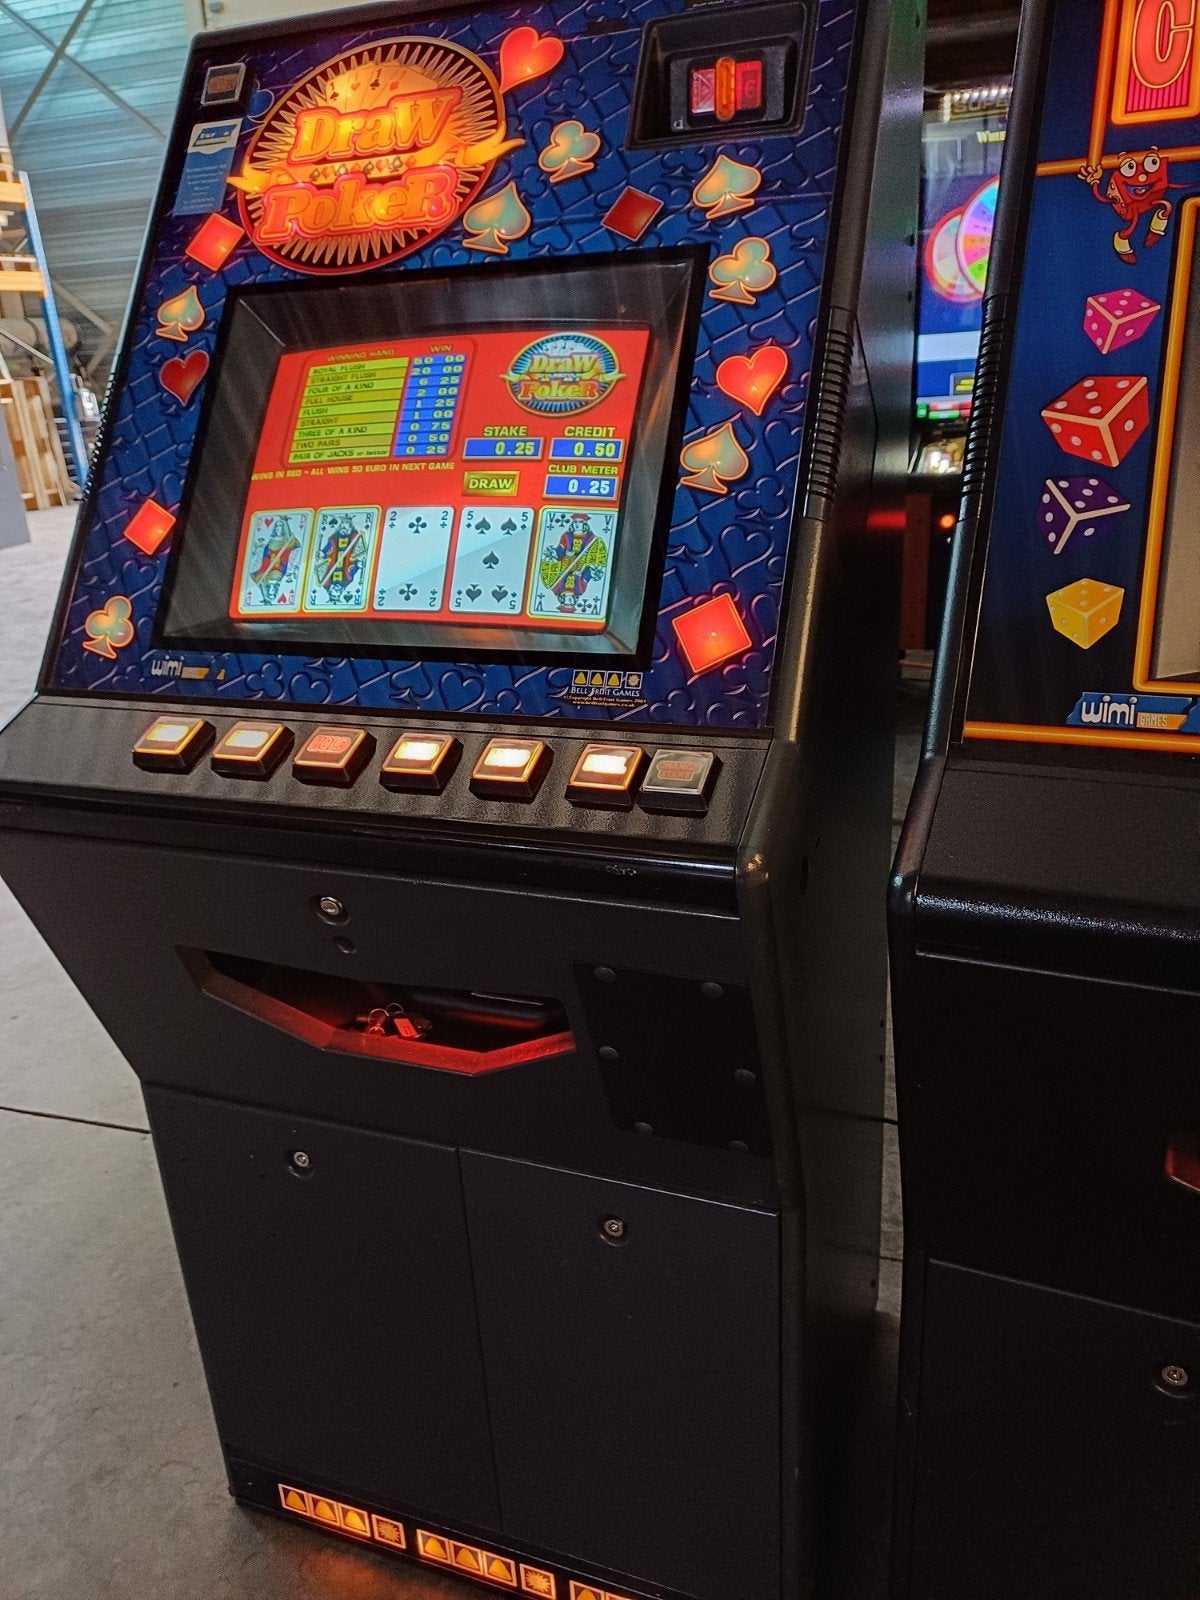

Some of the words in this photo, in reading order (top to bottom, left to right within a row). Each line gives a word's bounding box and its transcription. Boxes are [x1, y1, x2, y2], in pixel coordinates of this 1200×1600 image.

[430, 345, 453, 353] WIN
[328, 352, 366, 362] WINNING
[369, 349, 395, 358] HAND
[313, 367, 336, 375] ROYAL
[340, 363, 366, 372] FLUSH
[310, 373, 347, 384] STRAIGHT
[350, 371, 377, 380] FLUSH
[307, 386, 329, 395] FOUR
[354, 381, 375, 390] KIND
[305, 396, 323, 405] FULL
[326, 394, 353, 403] HOUSE
[302, 407, 329, 416] FLUSH
[300, 417, 339, 428] STRAIGHT
[298, 429, 321, 438] THREE
[347, 425, 368, 434] KIND
[484, 426, 528, 437] STAKE
[564, 426, 616, 438] CREDIT
[295, 441, 315, 449] TWO
[316, 439, 341, 447] PAIRS
[494, 441, 536, 456] 0.25
[573, 441, 617, 456] 0.50
[293, 451, 311, 460] PAIR
[313, 450, 325, 459] OF
[327, 449, 355, 458] JACKS
[274, 471, 285, 479] IN
[286, 470, 302, 478] RED
[310, 468, 325, 476] ALL
[327, 466, 350, 475] WINS
[351, 465, 364, 473] 50
[365, 464, 386, 473] EURO
[389, 463, 400, 472] IN
[402, 462, 427, 471] NEXT
[428, 461, 456, 471] GAME
[548, 463, 577, 474] CLUB
[581, 465, 619, 476] METER
[468, 478, 513, 490] DRAW
[568, 478, 611, 495] 0.25
[321, 514, 328, 525] R
[365, 513, 372, 523] R
[390, 511, 397, 521] 2
[441, 510, 449, 521] 2
[466, 510, 474, 520] 5
[521, 511, 529, 522] 5
[549, 513, 555, 523] V
[605, 515, 612, 526] V
[377, 596, 385, 606] 2
[428, 596, 437, 607] 2
[455, 597, 461, 608] 5
[509, 600, 516, 610] 5
[151, 655, 184, 676] wimi
[1081, 695, 1138, 725] wimi
[1140, 715, 1168, 727] GAMES
[307, 735, 351, 752] HOLD
